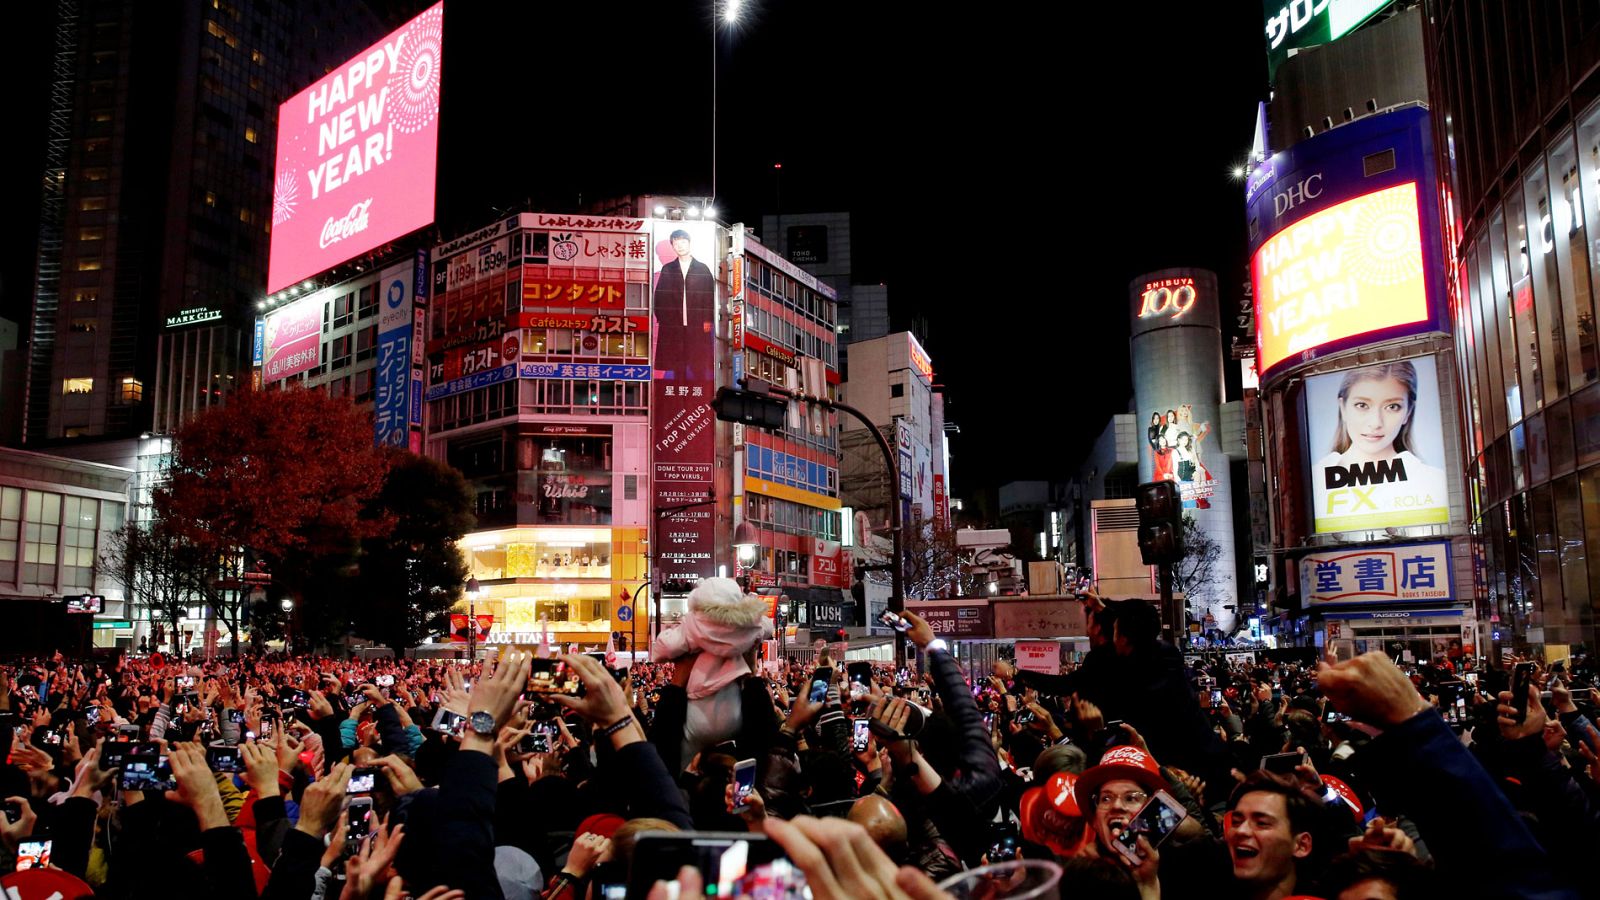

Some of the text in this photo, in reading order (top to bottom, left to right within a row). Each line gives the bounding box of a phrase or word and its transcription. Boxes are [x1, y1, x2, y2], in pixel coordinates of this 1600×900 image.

[308, 33, 406, 123] HAPPY
[318, 86, 388, 157] NEW
[308, 122, 393, 200] YEAR!
[1274, 172, 1323, 218] DHC
[319, 198, 373, 250] Coca-Cola
[539, 215, 644, 230] しゃぶしゃぶバイキング
[584, 239, 646, 259] しゃぶ葉
[1261, 203, 1363, 277] HAPPY
[436, 271, 447, 285] 9F
[1146, 278, 1194, 290] SHIBUYA
[1272, 245, 1345, 302] NEW
[523, 283, 622, 303] コンタクト
[1137, 284, 1196, 319] 109
[167, 309, 222, 325] MARK CITY
[180, 307, 207, 316] SHIBUYA
[590, 315, 637, 333] ガスト
[271, 345, 316, 375] 品川美容外科
[431, 363, 444, 379] 7F
[463, 346, 499, 375] ガスト
[525, 364, 649, 378] AEON 英会話イーオン
[377, 340, 395, 448] アイシティ
[392, 336, 407, 445] コンタクトの
[664, 385, 703, 397] 星野源
[674, 439, 688, 454] NOW
[687, 431, 696, 441] ON
[900, 426, 911, 450] OS
[1324, 457, 1408, 490] DMM
[1326, 486, 1379, 515] FX
[1393, 494, 1434, 508] ROLA
[818, 558, 837, 573] アコム
[815, 605, 842, 621] LUSH
[927, 619, 956, 633] 谷駅
